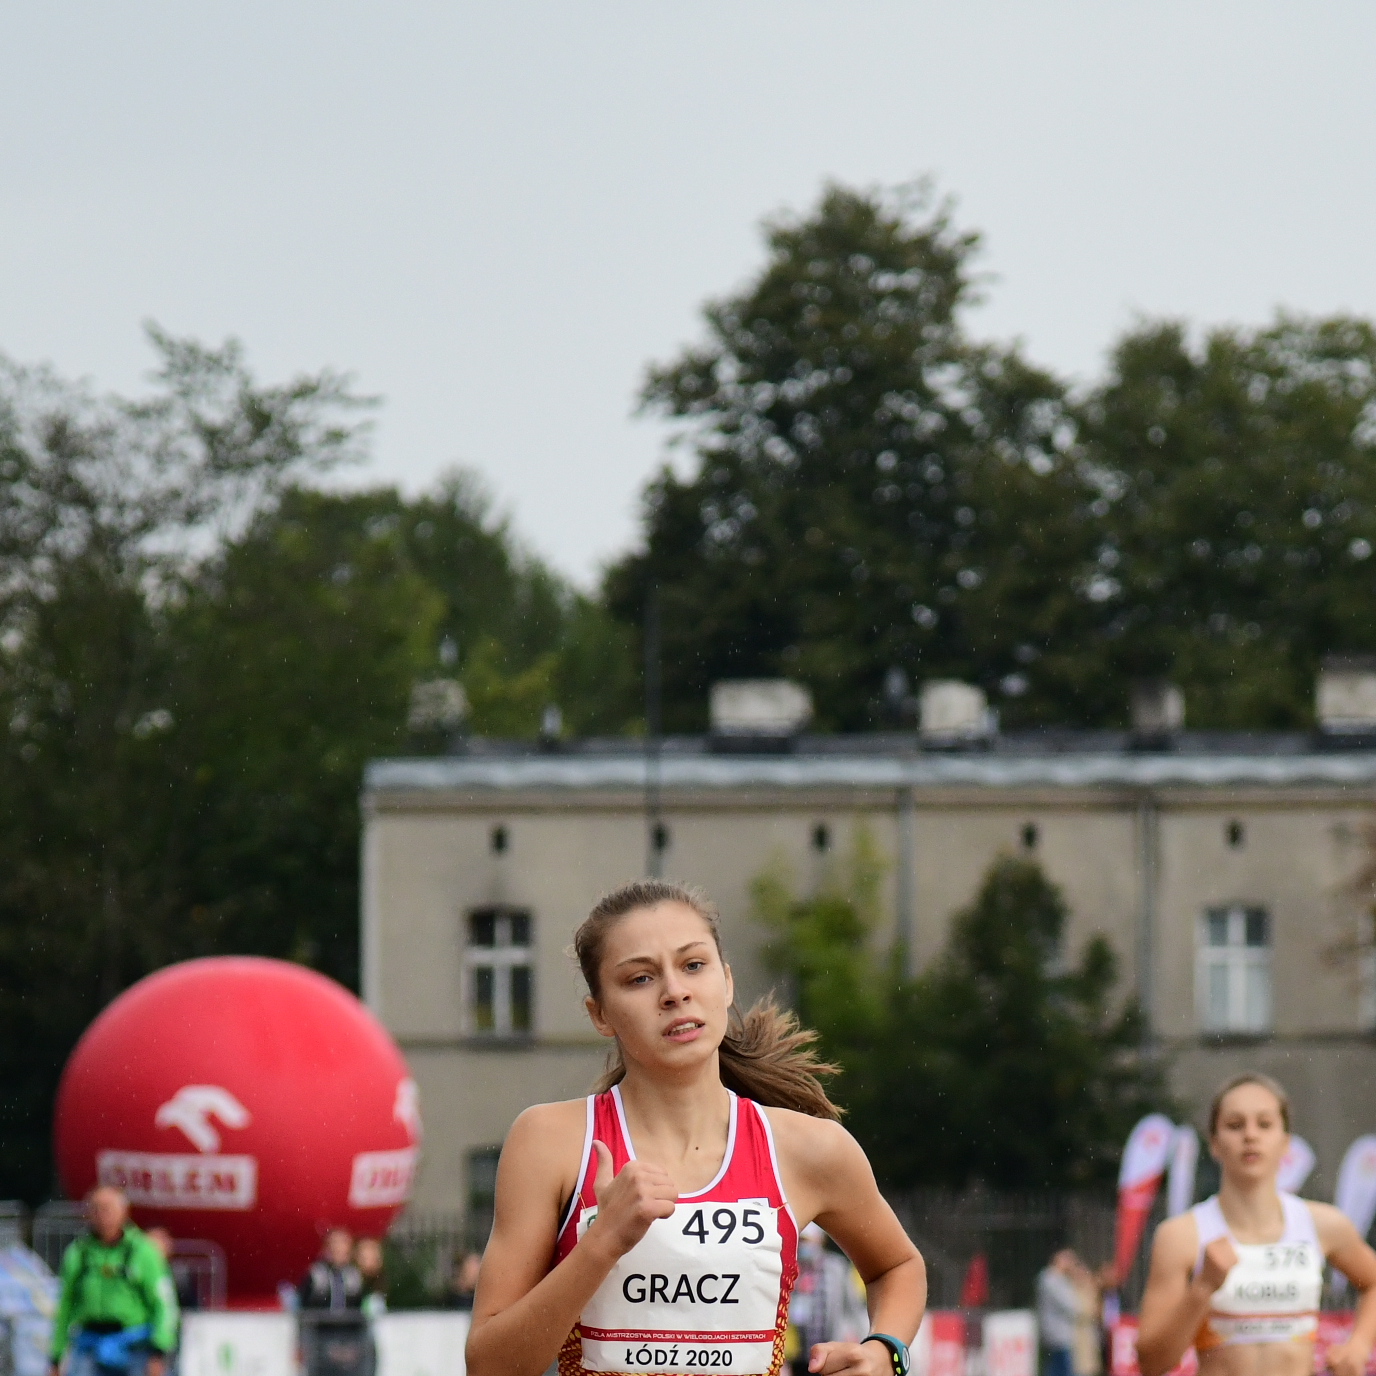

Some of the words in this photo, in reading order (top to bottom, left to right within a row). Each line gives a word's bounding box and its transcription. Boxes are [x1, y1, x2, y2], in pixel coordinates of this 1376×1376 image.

[682, 1208, 765, 1245] 495
[622, 1273, 741, 1304] GRACZ
[684, 1333, 728, 1341] WIELOBOJACH
[624, 1343, 679, 1366] ŁÓDŹ
[686, 1349, 733, 1367] 2020
